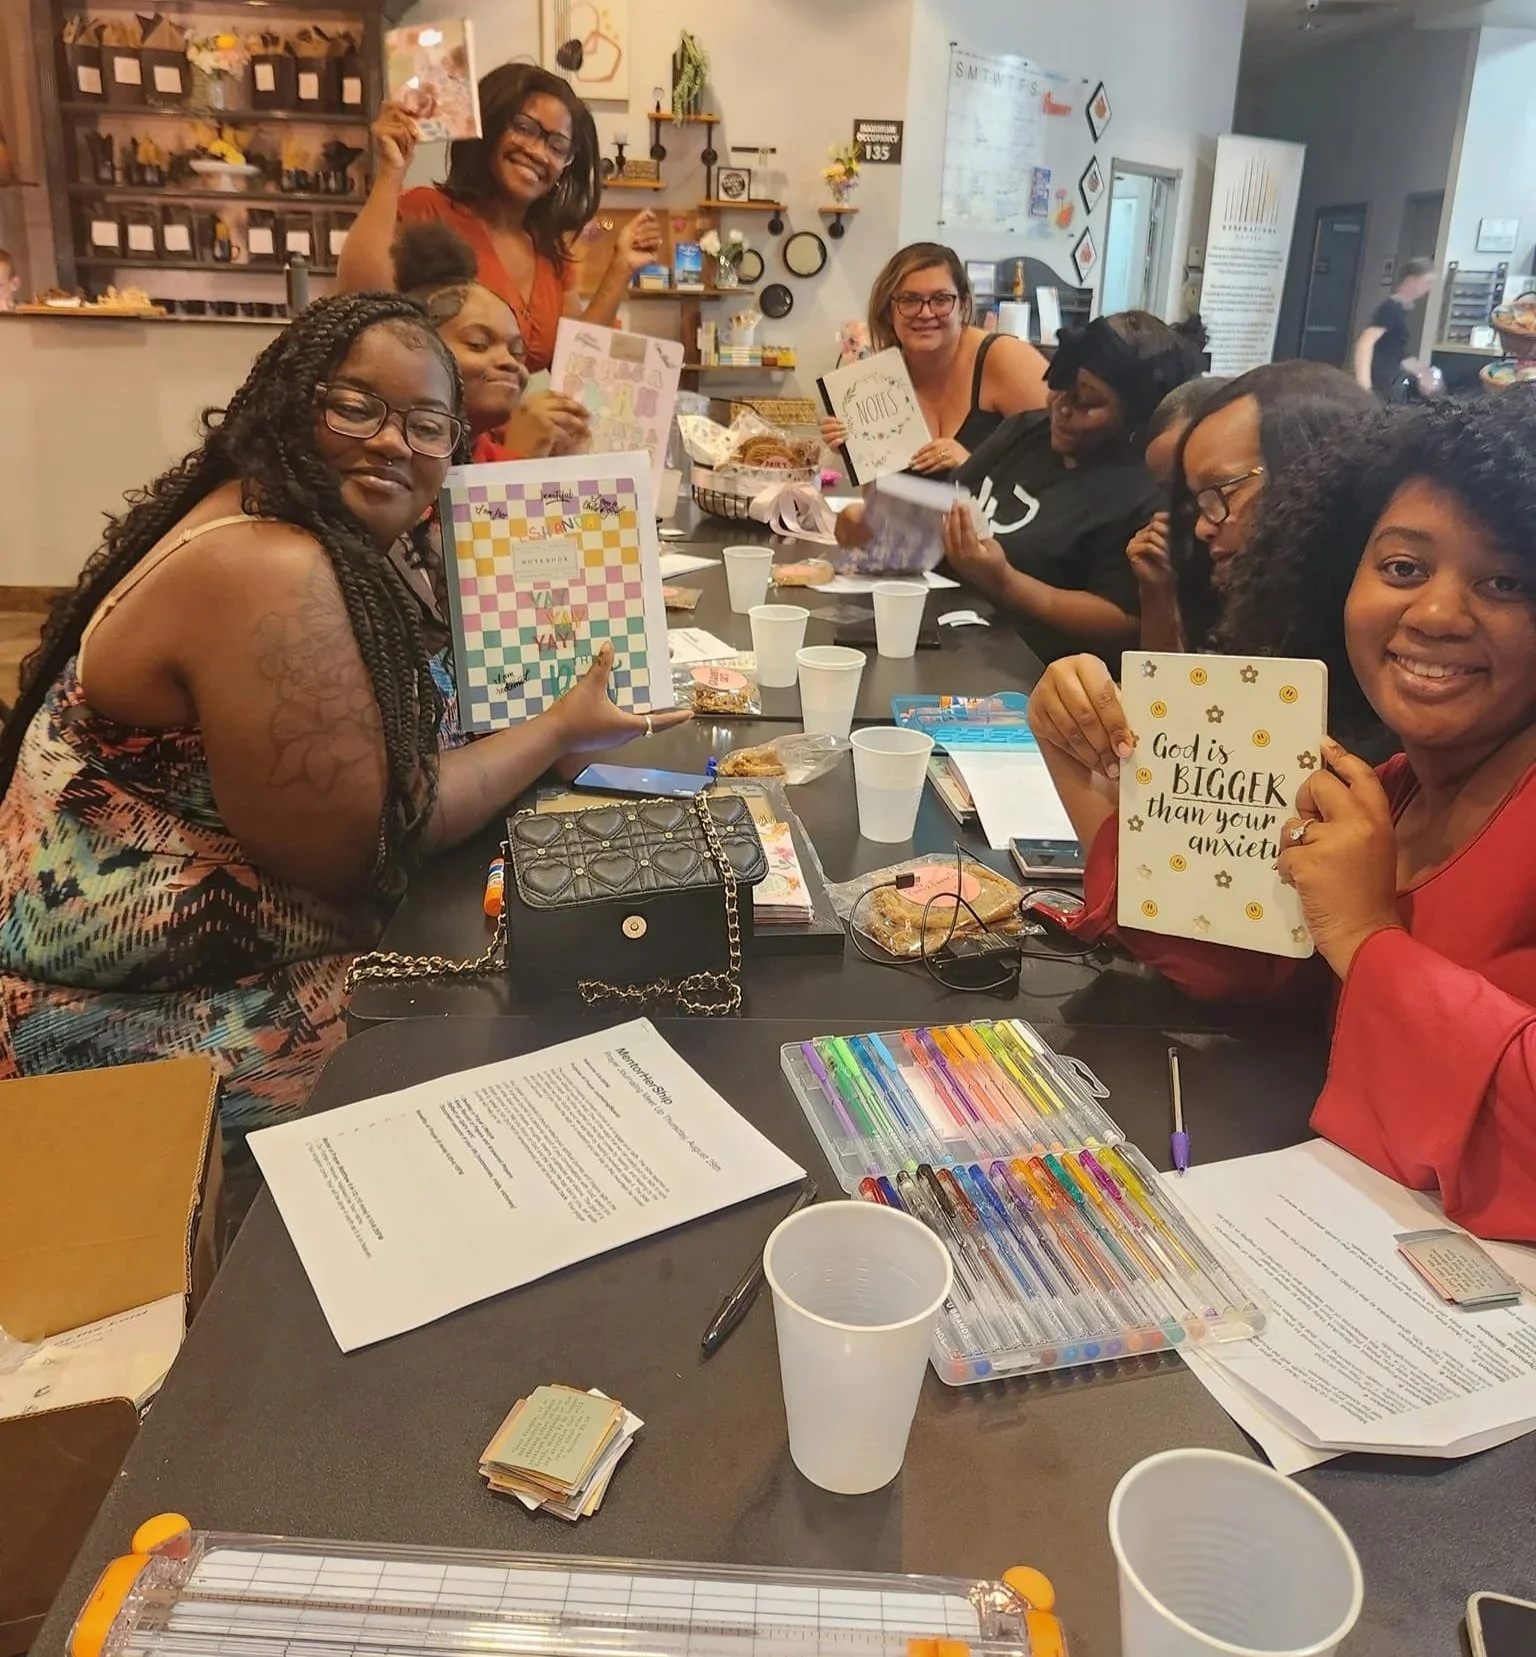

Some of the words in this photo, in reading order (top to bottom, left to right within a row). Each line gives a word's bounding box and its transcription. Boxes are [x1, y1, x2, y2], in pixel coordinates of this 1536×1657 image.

[856, 132, 900, 144] OCCUPANCY
[859, 122, 897, 134] MAXIMUM
[864, 144, 890, 162] 135
[855, 390, 898, 427] NOTES
[540, 488, 574, 502] beautiful
[521, 556, 569, 565] NOTEBOOK
[530, 590, 568, 609] YAY
[546, 609, 586, 629] YAY
[532, 630, 578, 653] YAY!
[1152, 731, 1200, 763] God
[1208, 738, 1234, 764] is
[1172, 763, 1288, 807] BIGGER
[1147, 792, 1212, 826] than
[1216, 807, 1276, 834] your
[615, 1047, 673, 1106] MentorHerShip
[948, 1307, 972, 1340] BRANDS
